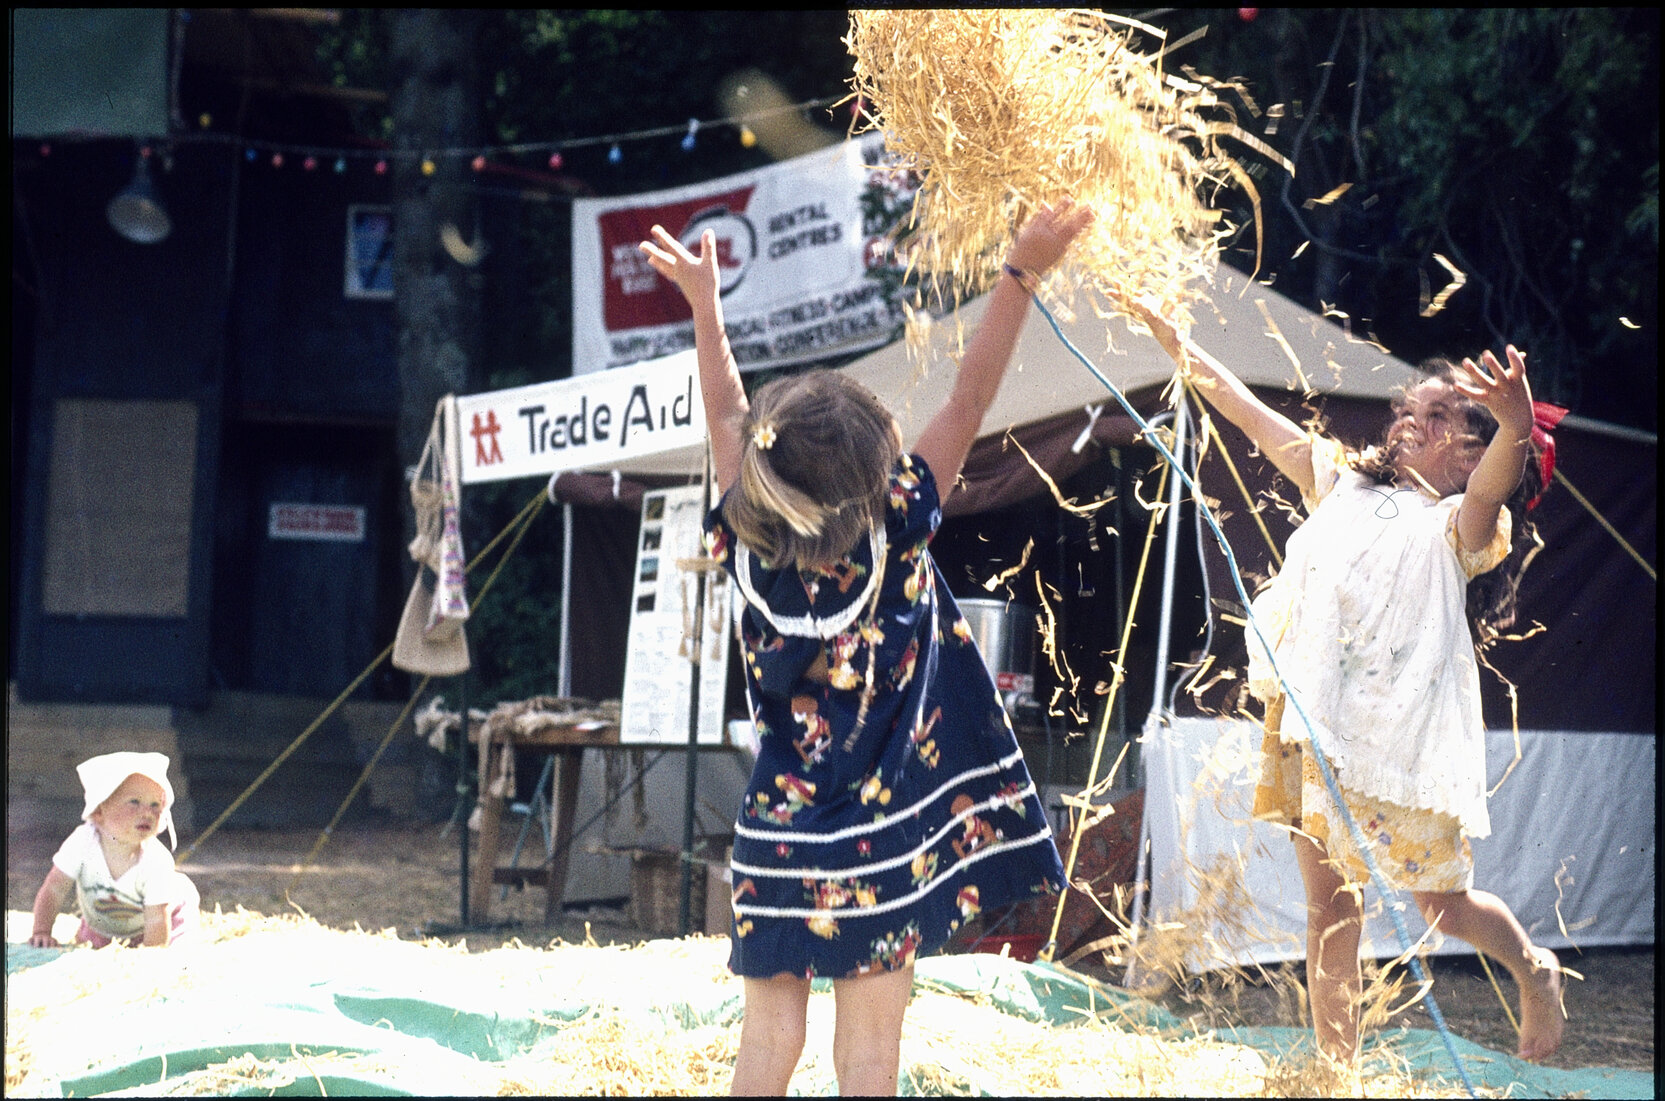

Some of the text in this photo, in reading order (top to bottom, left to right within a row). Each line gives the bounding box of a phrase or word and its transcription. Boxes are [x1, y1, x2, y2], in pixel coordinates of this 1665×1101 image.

[769, 201, 830, 234] RENTAL
[768, 222, 843, 261] CENTRES
[518, 374, 693, 455] Trade Aid
